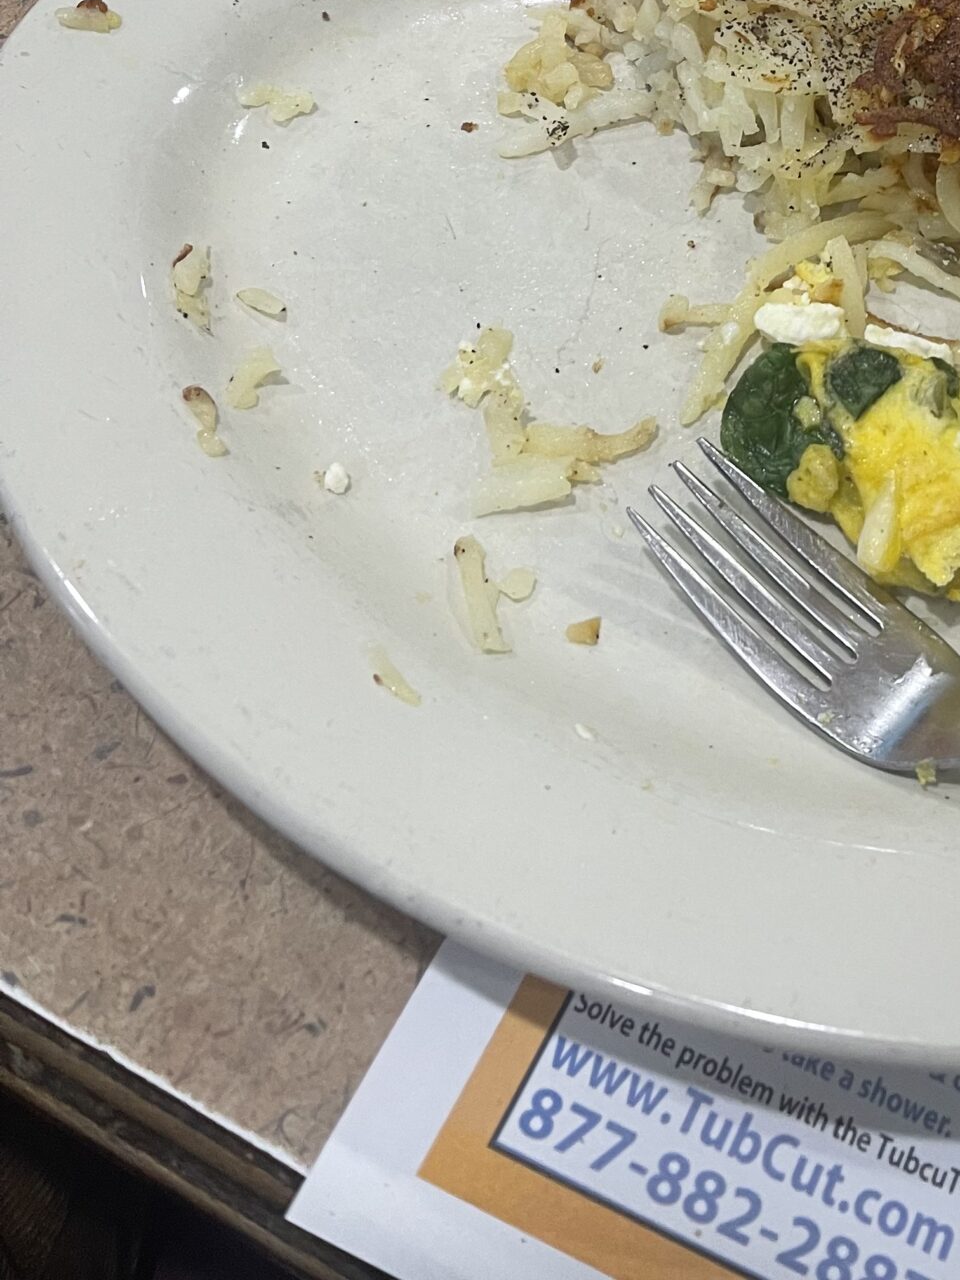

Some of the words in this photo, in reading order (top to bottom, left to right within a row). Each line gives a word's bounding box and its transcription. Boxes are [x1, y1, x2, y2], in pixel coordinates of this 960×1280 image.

[551, 1034, 955, 1262] www.TubCut.com
[574, 994, 635, 1037] Solve
[638, 1021, 676, 1057] the
[675, 1043, 774, 1106] problem
[779, 1083, 829, 1132] with
[830, 1113, 871, 1153] the
[782, 1051, 834, 1082] ake
[839, 1072, 856, 1092] a
[859, 1076, 952, 1138] shower.
